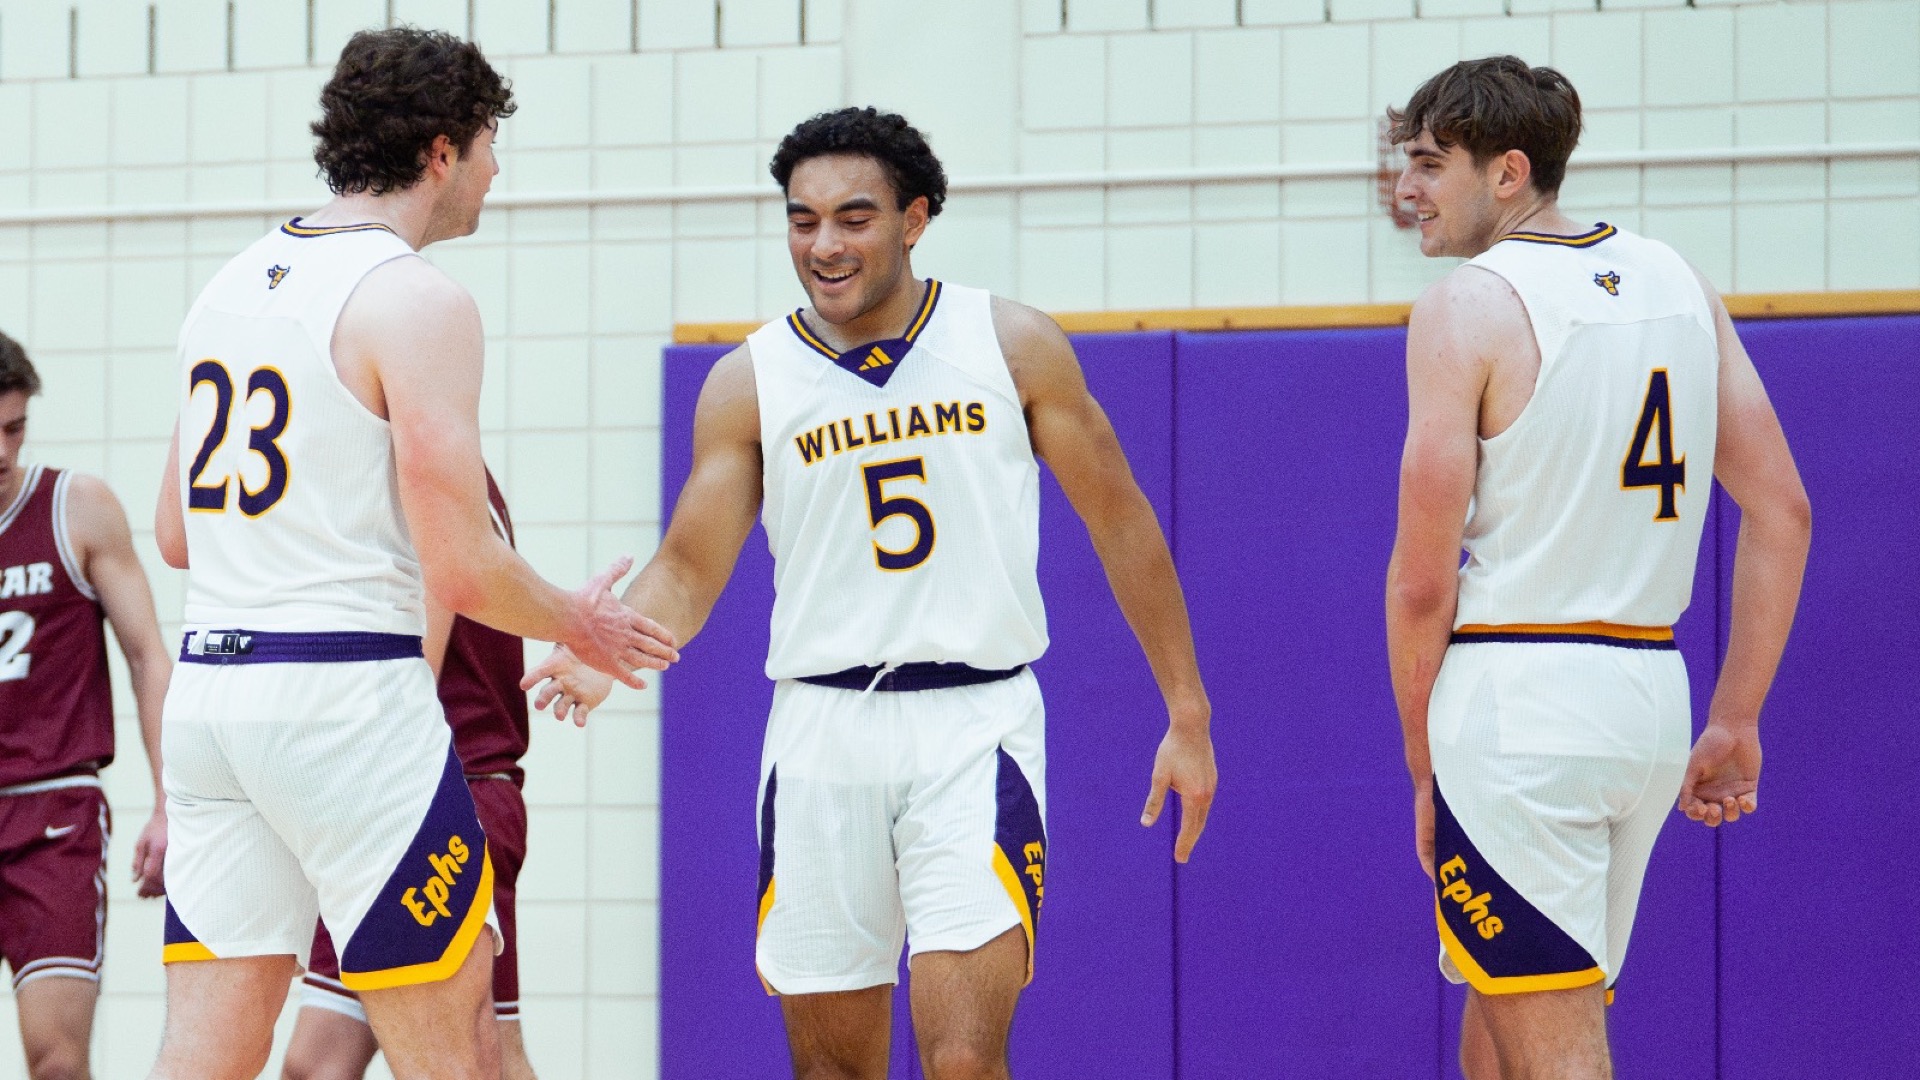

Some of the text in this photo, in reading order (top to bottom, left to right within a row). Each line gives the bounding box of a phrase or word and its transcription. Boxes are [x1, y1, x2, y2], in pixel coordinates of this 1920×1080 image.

[188, 358, 293, 520] 23
[794, 400, 987, 466] WILLIAMS
[1619, 367, 1686, 522] 4
[860, 455, 937, 572] 5
[0, 562, 54, 599] AR
[400, 834, 470, 928] Ephs
[1439, 854, 1505, 941] Ephs
